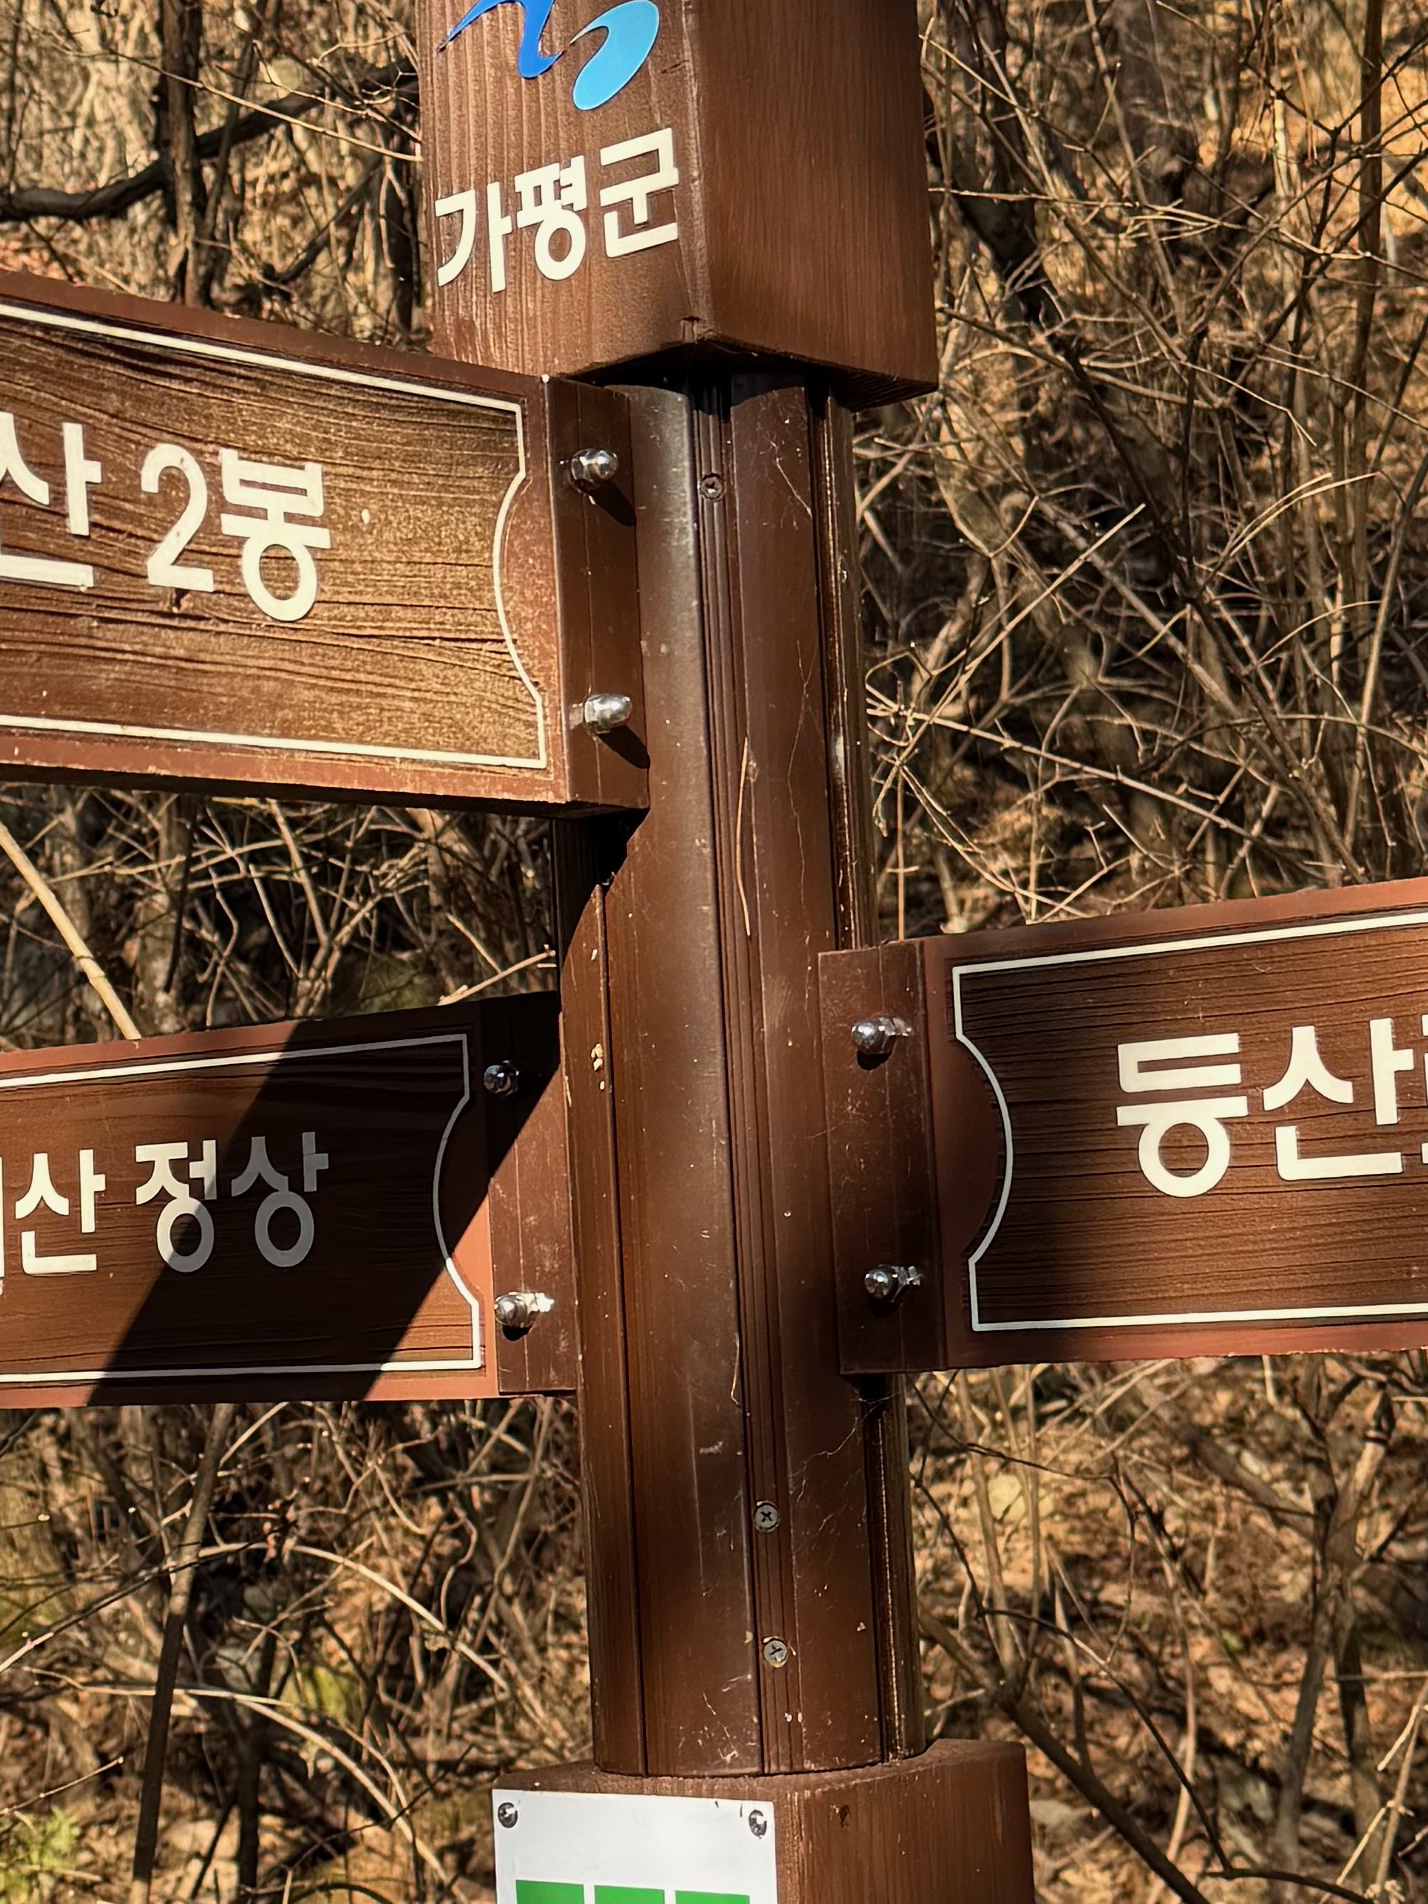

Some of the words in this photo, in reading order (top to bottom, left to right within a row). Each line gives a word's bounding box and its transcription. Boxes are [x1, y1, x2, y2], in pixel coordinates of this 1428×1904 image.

[434, 127, 680, 293] 가평군
[139, 442, 332, 623] 2봉
[133, 1130, 330, 1275] 정상
